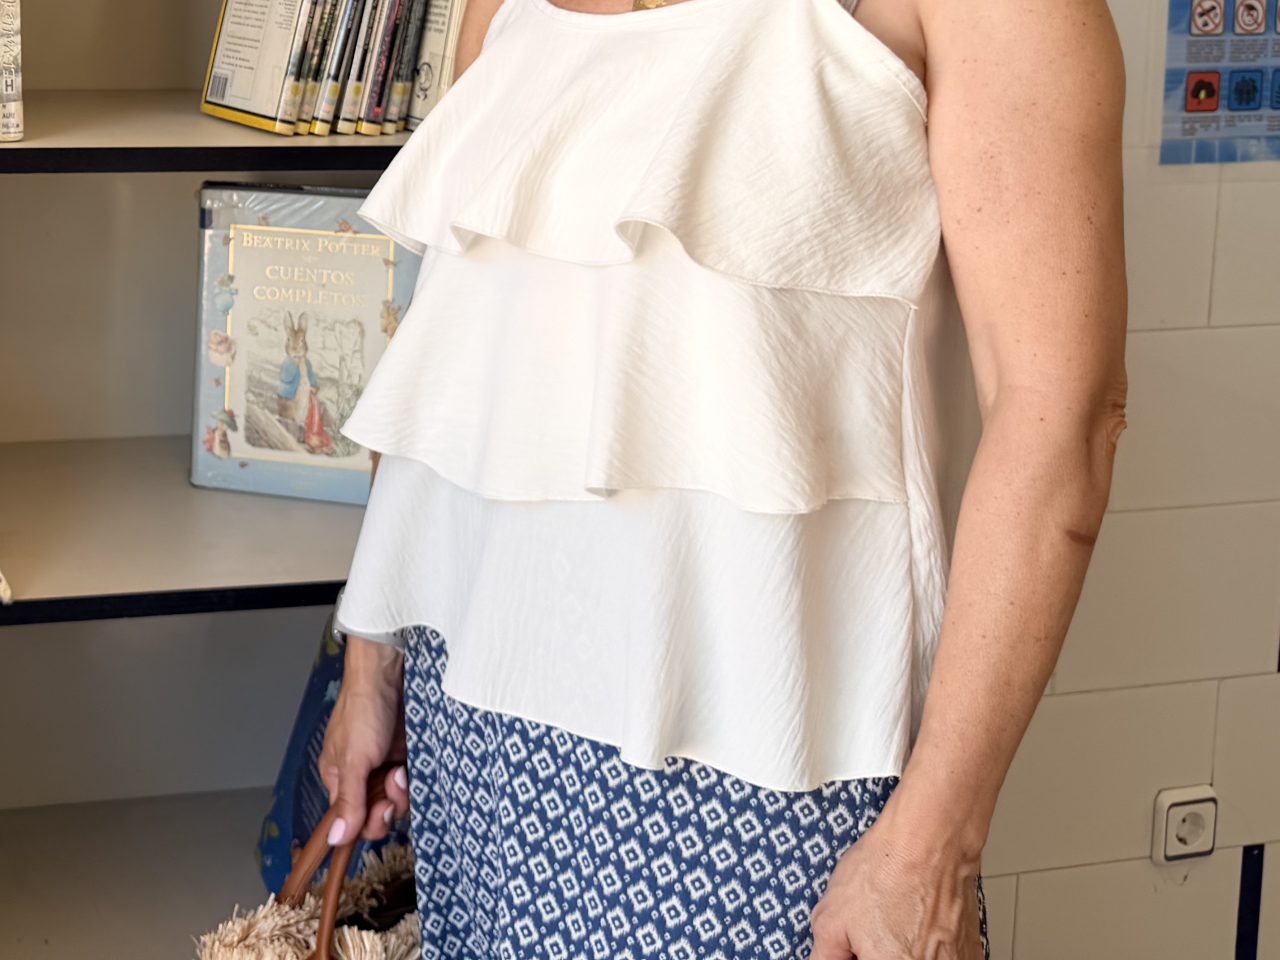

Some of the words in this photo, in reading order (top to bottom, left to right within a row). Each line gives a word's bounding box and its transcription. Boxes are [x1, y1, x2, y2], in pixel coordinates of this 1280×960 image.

[3, 13, 14, 56] Valle
[5, 80, 13, 92] H
[242, 232, 310, 251] BEATRIX
[318, 239, 380, 256] POTTER
[266, 266, 355, 285] CUENTOS
[254, 286, 368, 306] COMPLETOS
